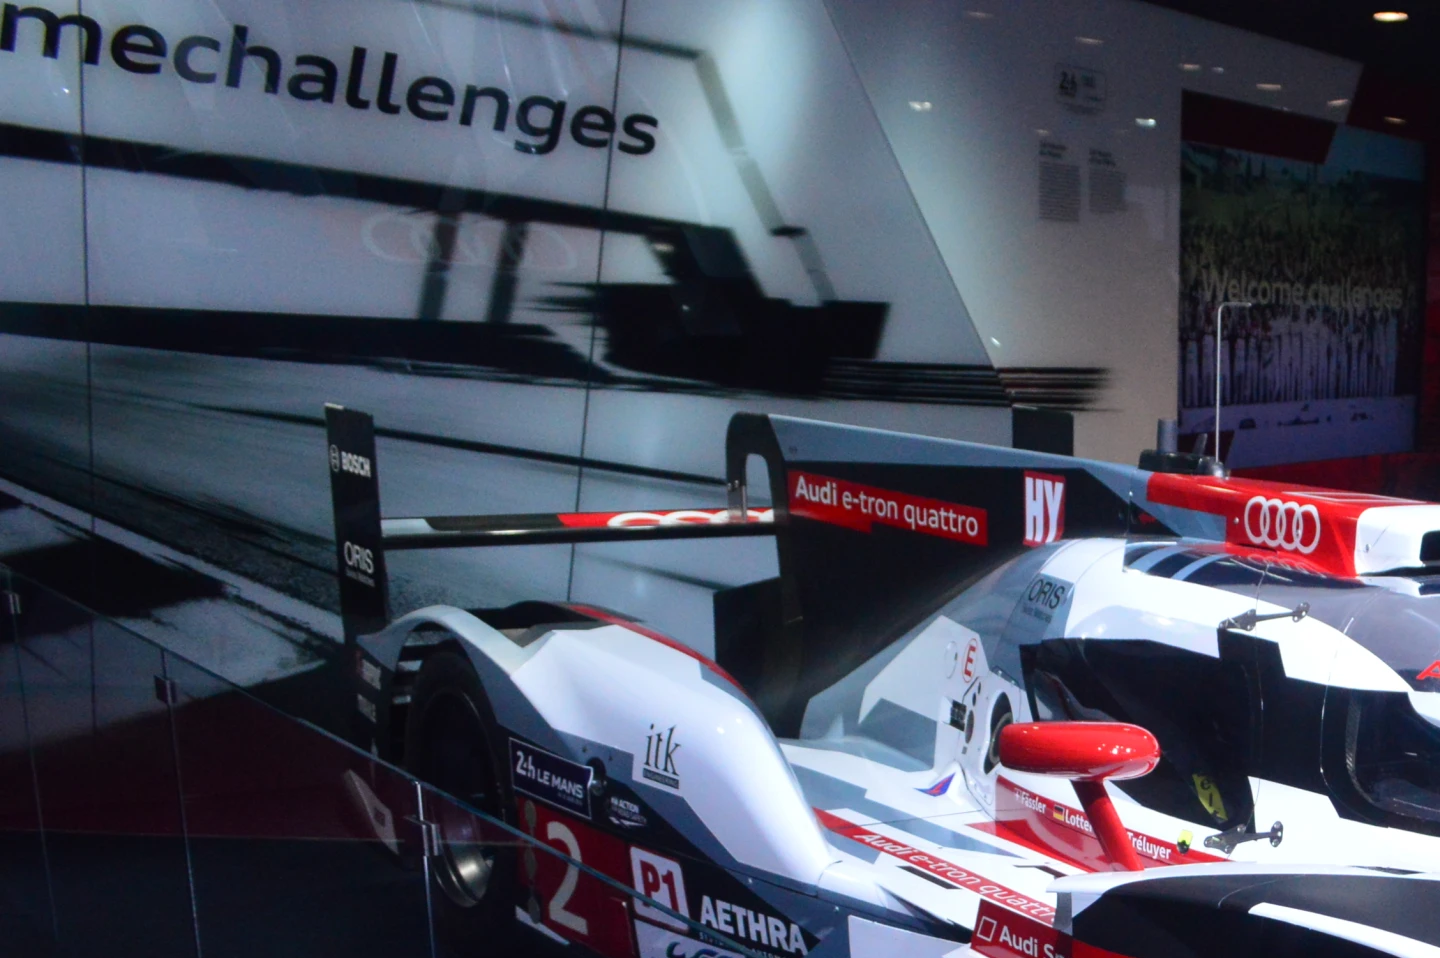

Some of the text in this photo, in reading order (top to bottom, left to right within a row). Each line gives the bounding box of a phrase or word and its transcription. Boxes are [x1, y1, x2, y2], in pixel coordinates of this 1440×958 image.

[340, 451, 372, 478] BOSCH
[795, 475, 979, 537] Audi e-tron quattro
[1024, 475, 1065, 543] HY
[344, 540, 375, 574] ORIS
[1028, 578, 1066, 610] ORIS
[643, 723, 682, 776] itk
[537, 768, 551, 787] LE
[552, 775, 585, 799] MANS
[1021, 790, 1047, 815] Fässler
[546, 820, 590, 937] 2
[640, 859, 681, 916] P1
[854, 833, 1056, 922] Audi e-tron quattr
[700, 894, 809, 957] AETHRA
[999, 924, 1039, 958] Audi
